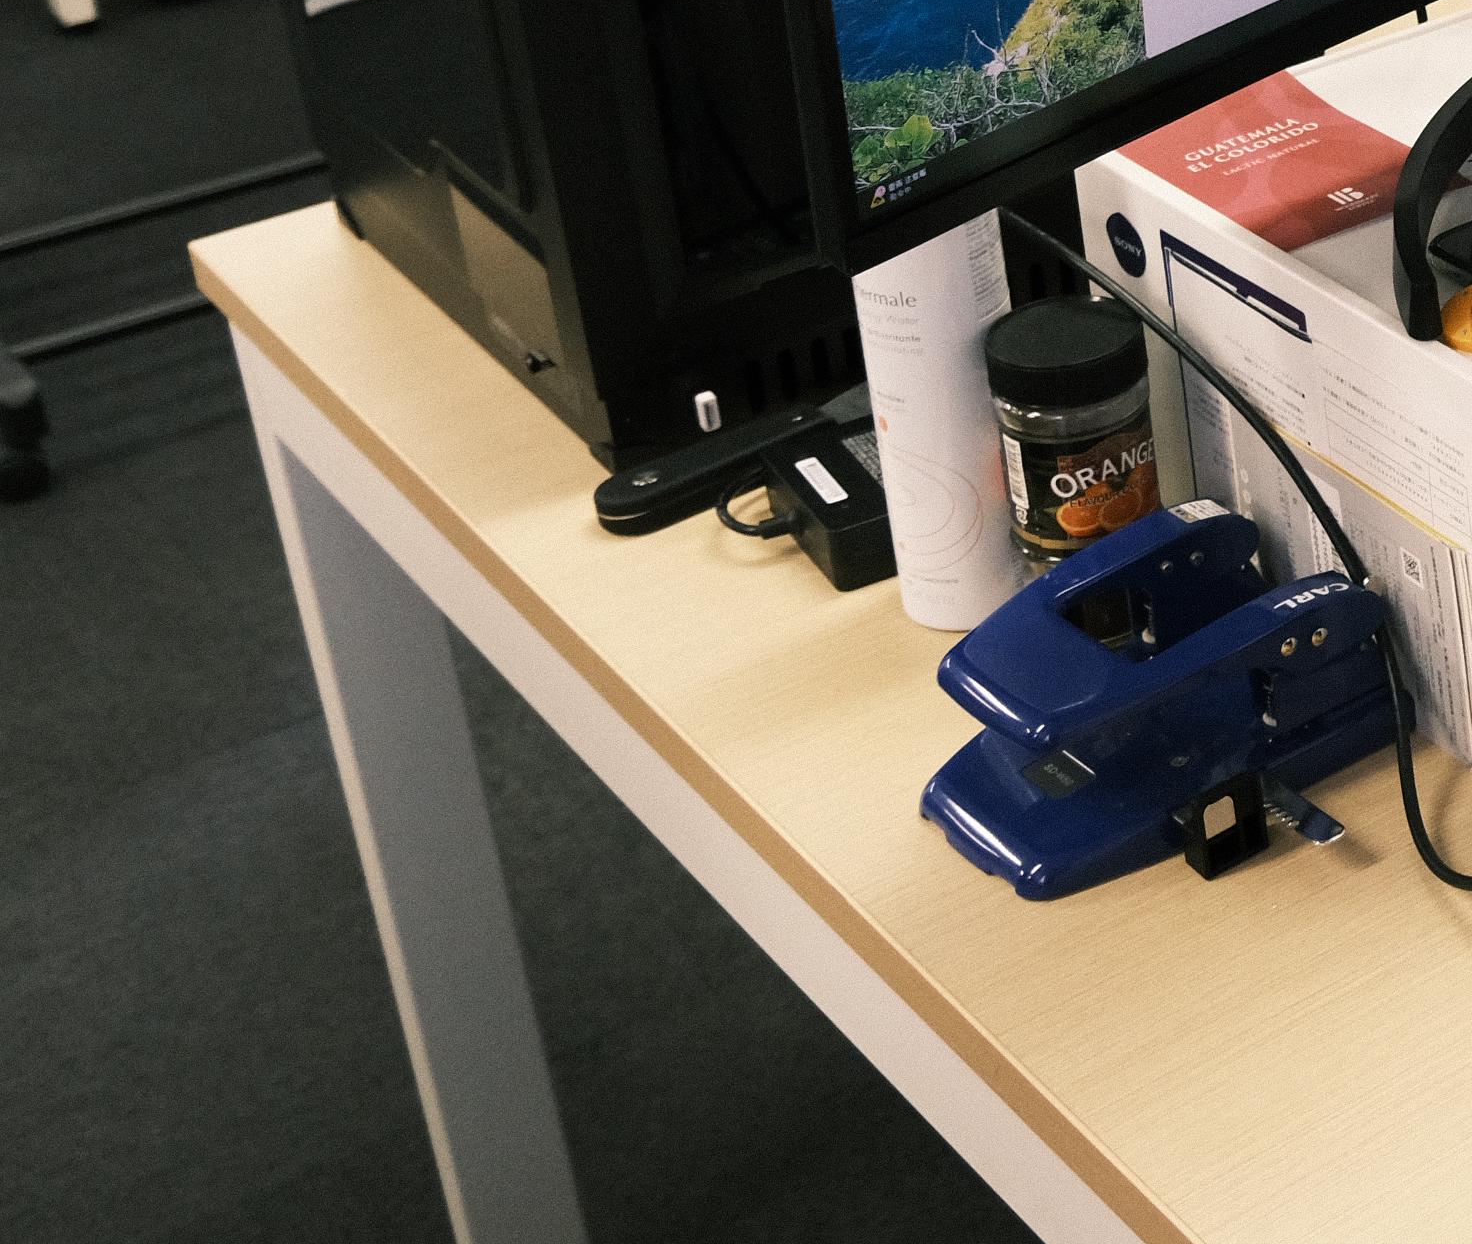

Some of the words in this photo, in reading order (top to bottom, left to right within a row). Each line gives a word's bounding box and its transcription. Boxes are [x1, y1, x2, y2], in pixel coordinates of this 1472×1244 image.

[1185, 118, 1300, 162] GUATEMALA
[1187, 161, 1212, 173] EL
[1215, 122, 1319, 163] COLORIDO
[1223, 157, 1266, 176] LACTIC
[1267, 139, 1320, 160] NATURAL
[1114, 236, 1141, 257] SONY
[1050, 438, 1155, 499] ORANGE
[1274, 583, 1349, 609] CARL
